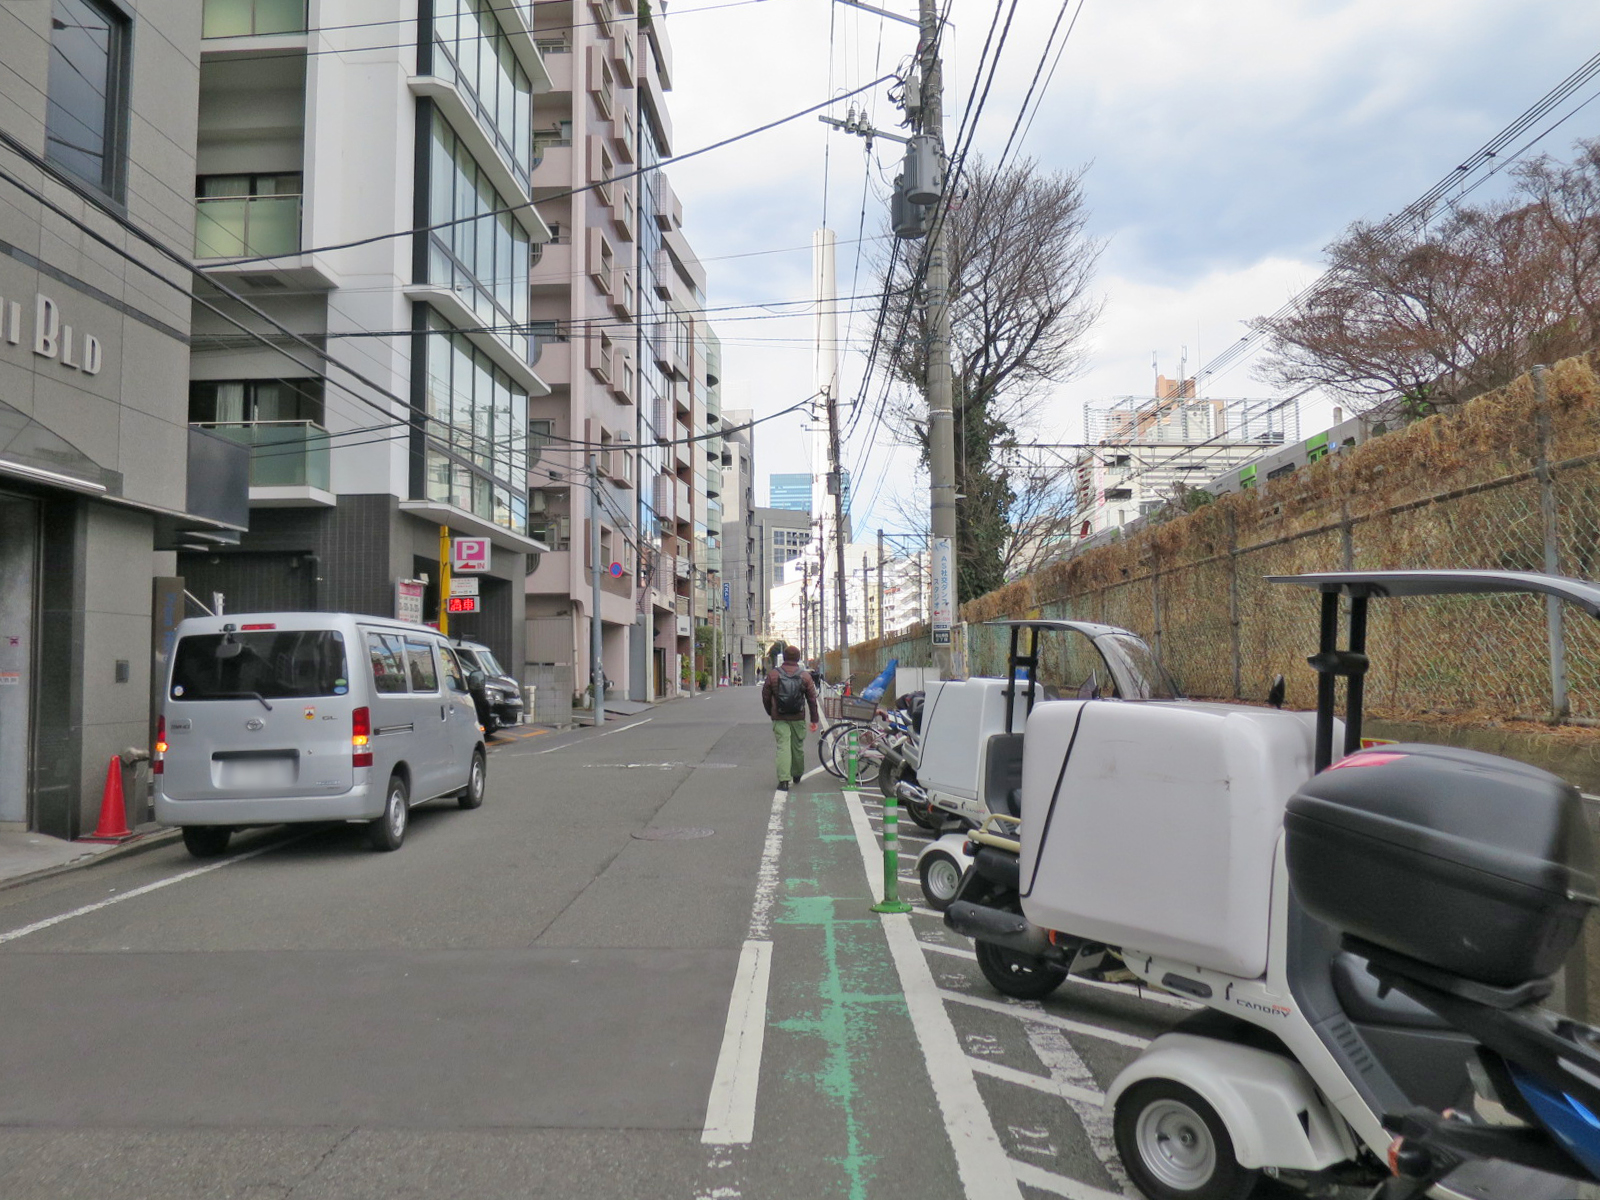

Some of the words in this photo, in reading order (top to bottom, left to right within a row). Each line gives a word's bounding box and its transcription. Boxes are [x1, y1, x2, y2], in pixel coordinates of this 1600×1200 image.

[33, 293, 102, 375] BLD
[461, 542, 479, 560] P
[450, 598, 474, 611] 満車
[1236, 999, 1291, 1018] CANOPY
